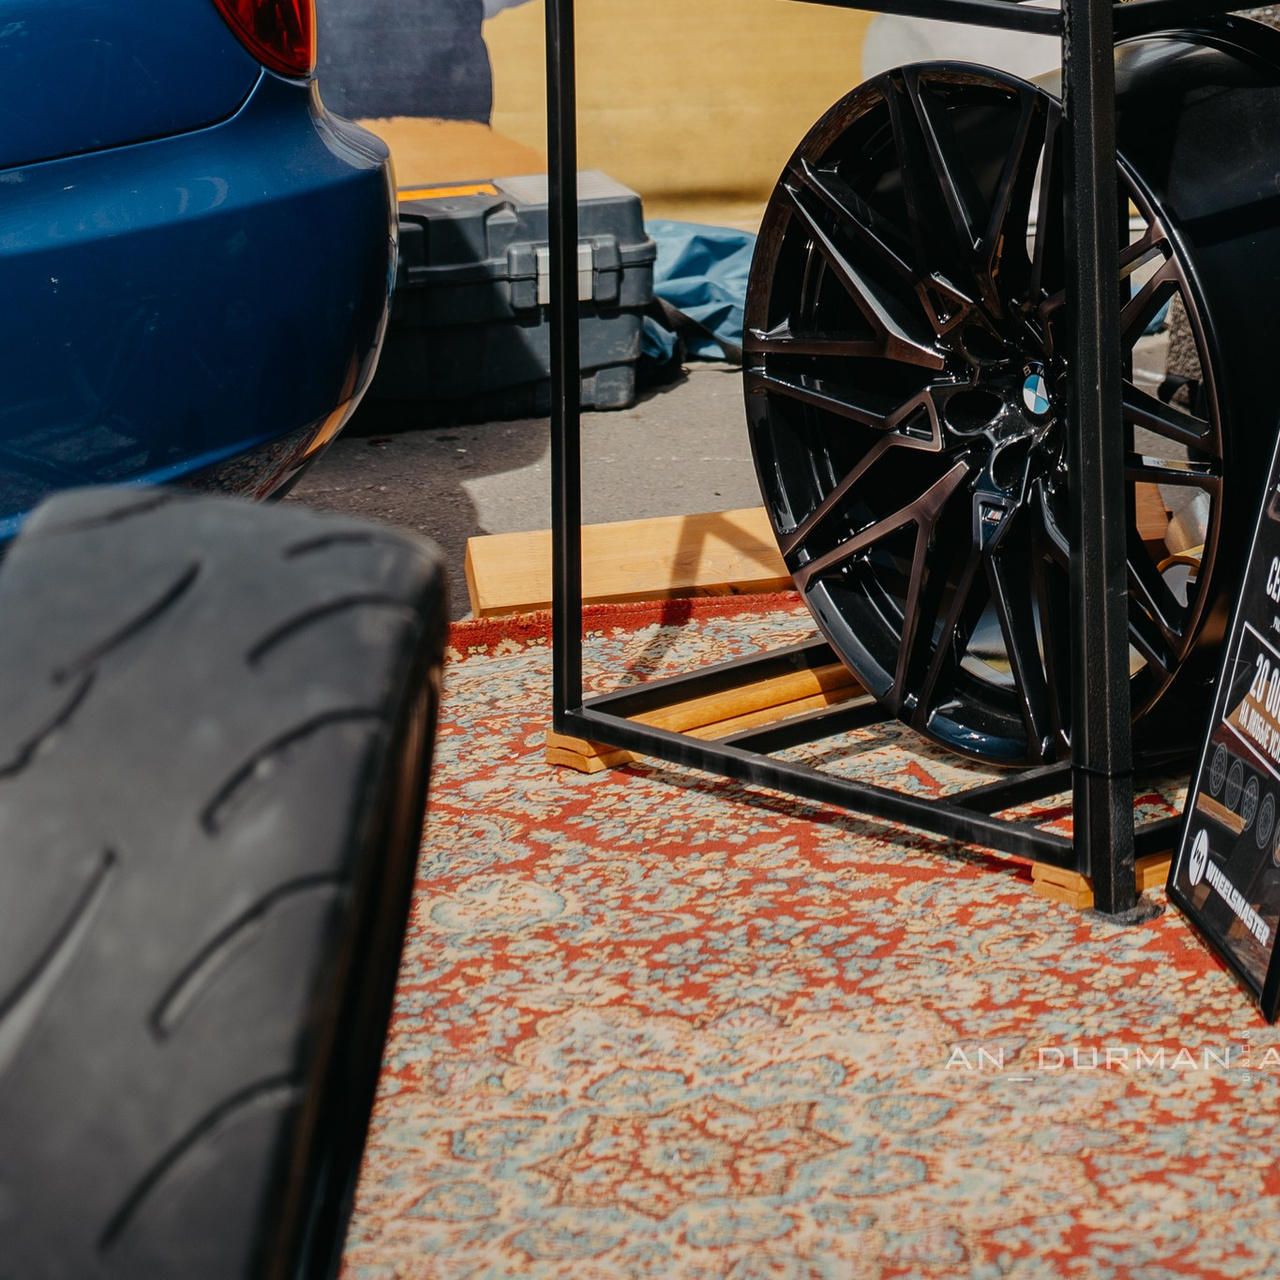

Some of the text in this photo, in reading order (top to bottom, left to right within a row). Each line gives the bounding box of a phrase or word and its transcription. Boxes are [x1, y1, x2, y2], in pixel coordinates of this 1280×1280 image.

[1249, 651, 1270, 705] 20
[1238, 700, 1250, 727] НА
[1204, 858, 1272, 947] WHEELSMASTER
